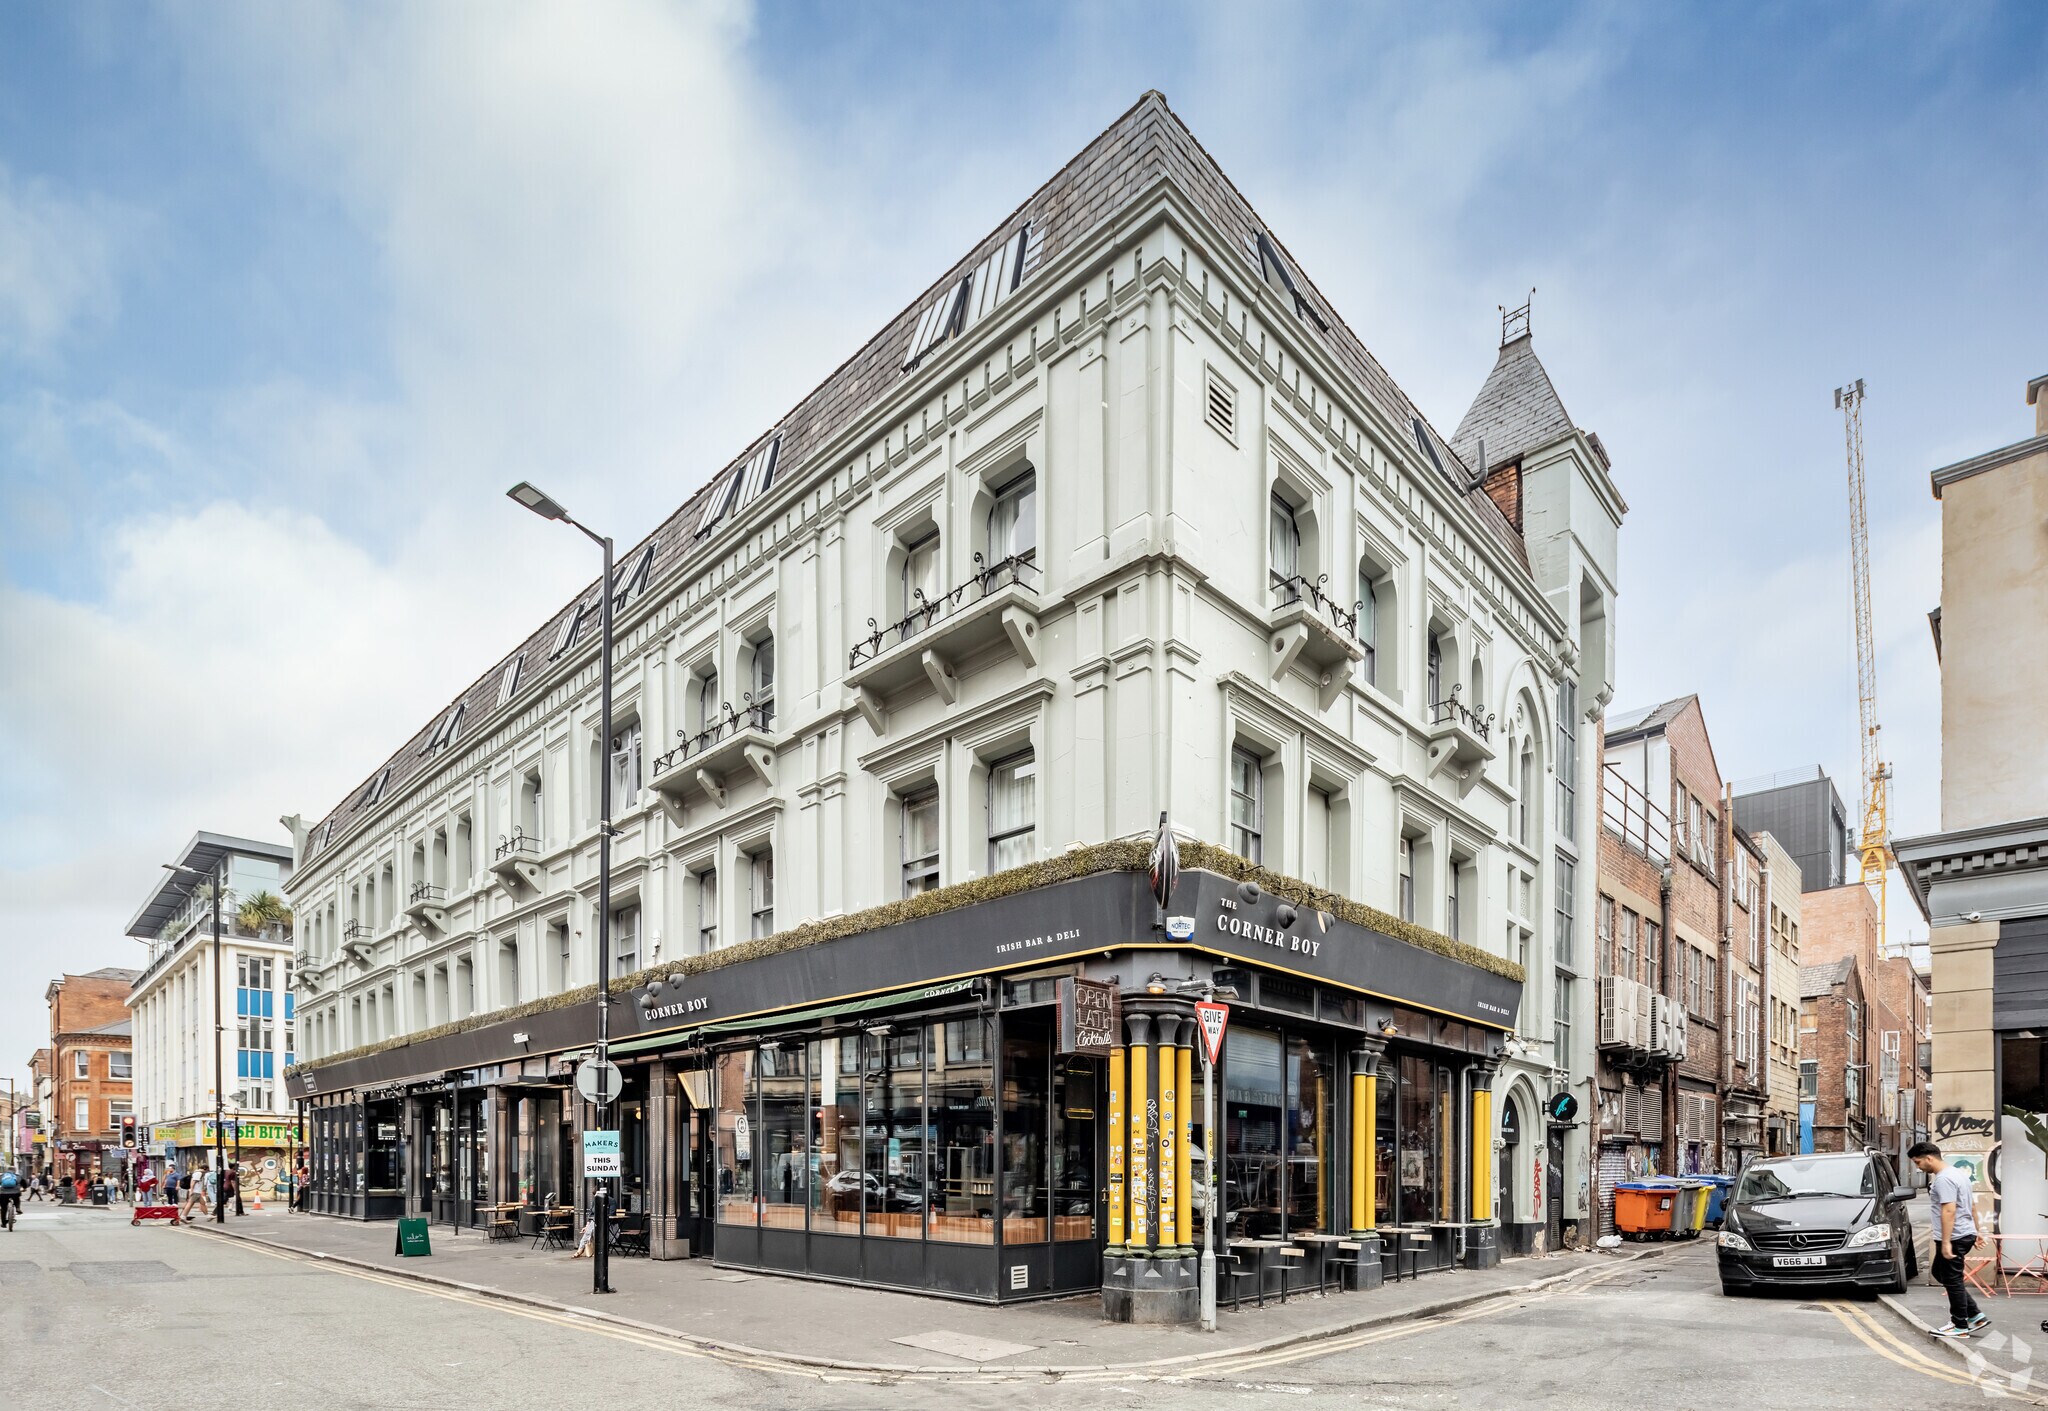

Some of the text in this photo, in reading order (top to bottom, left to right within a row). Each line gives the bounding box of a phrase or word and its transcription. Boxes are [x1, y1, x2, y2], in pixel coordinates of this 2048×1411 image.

[1221, 897, 1237, 910] THE
[1171, 922, 1191, 930] NORTEC
[996, 928, 1080, 953] IRISH BAR & DELI
[1217, 914, 1320, 957] CORNER BOY
[1076, 987, 1112, 1009] OPEN
[645, 997, 708, 1021] CORNER BOY
[1076, 1008, 1109, 1029] LATE
[1204, 1010, 1222, 1024] GIVE
[1208, 1026, 1219, 1034] WAY
[1077, 1030, 1112, 1047] Cocktails
[585, 1140, 618, 1148] MAKERS
[1777, 1256, 1823, 1266] V666 JLJ
